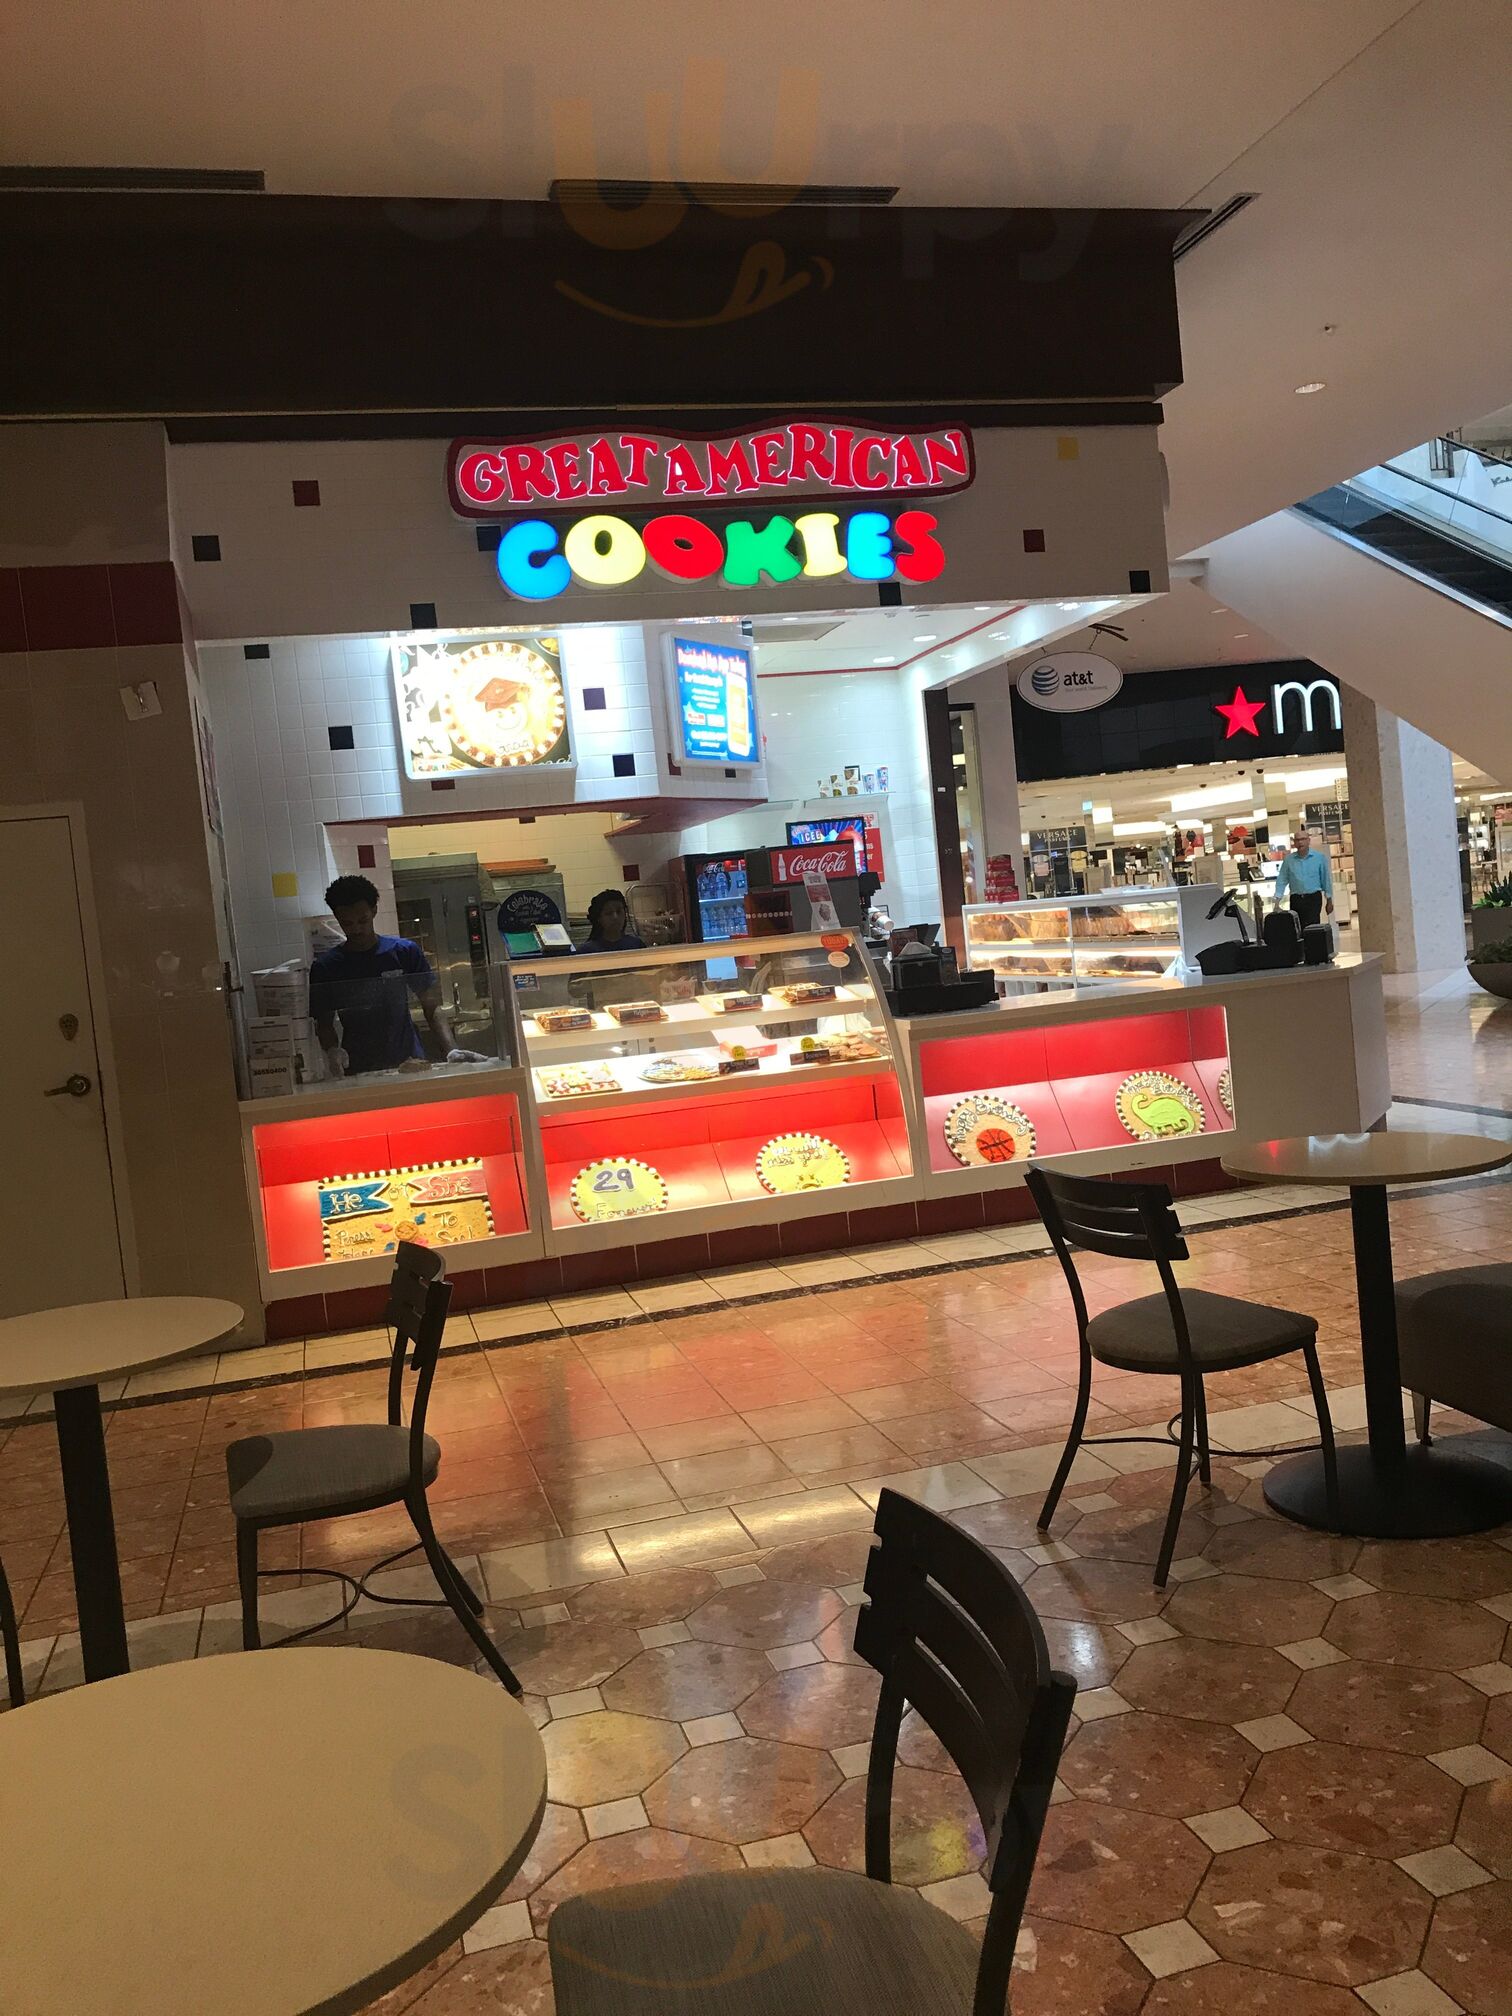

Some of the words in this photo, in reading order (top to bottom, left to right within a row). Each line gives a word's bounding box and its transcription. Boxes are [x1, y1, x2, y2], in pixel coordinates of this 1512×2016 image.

[459, 435, 658, 503] GREAT
[662, 423, 968, 496] AMERICAN
[497, 510, 946, 600] COOKIES
[1063, 670, 1094, 686] at&t
[1311, 803, 1349, 815] VERSACE
[800, 830, 821, 844] ICEE
[1036, 828, 1079, 841] VERSACE
[790, 850, 849, 877] Coca-Cola
[592, 1168, 635, 1194] 29
[328, 1191, 364, 1215] He
[428, 1175, 474, 1198] She
[432, 1210, 459, 1229] To
